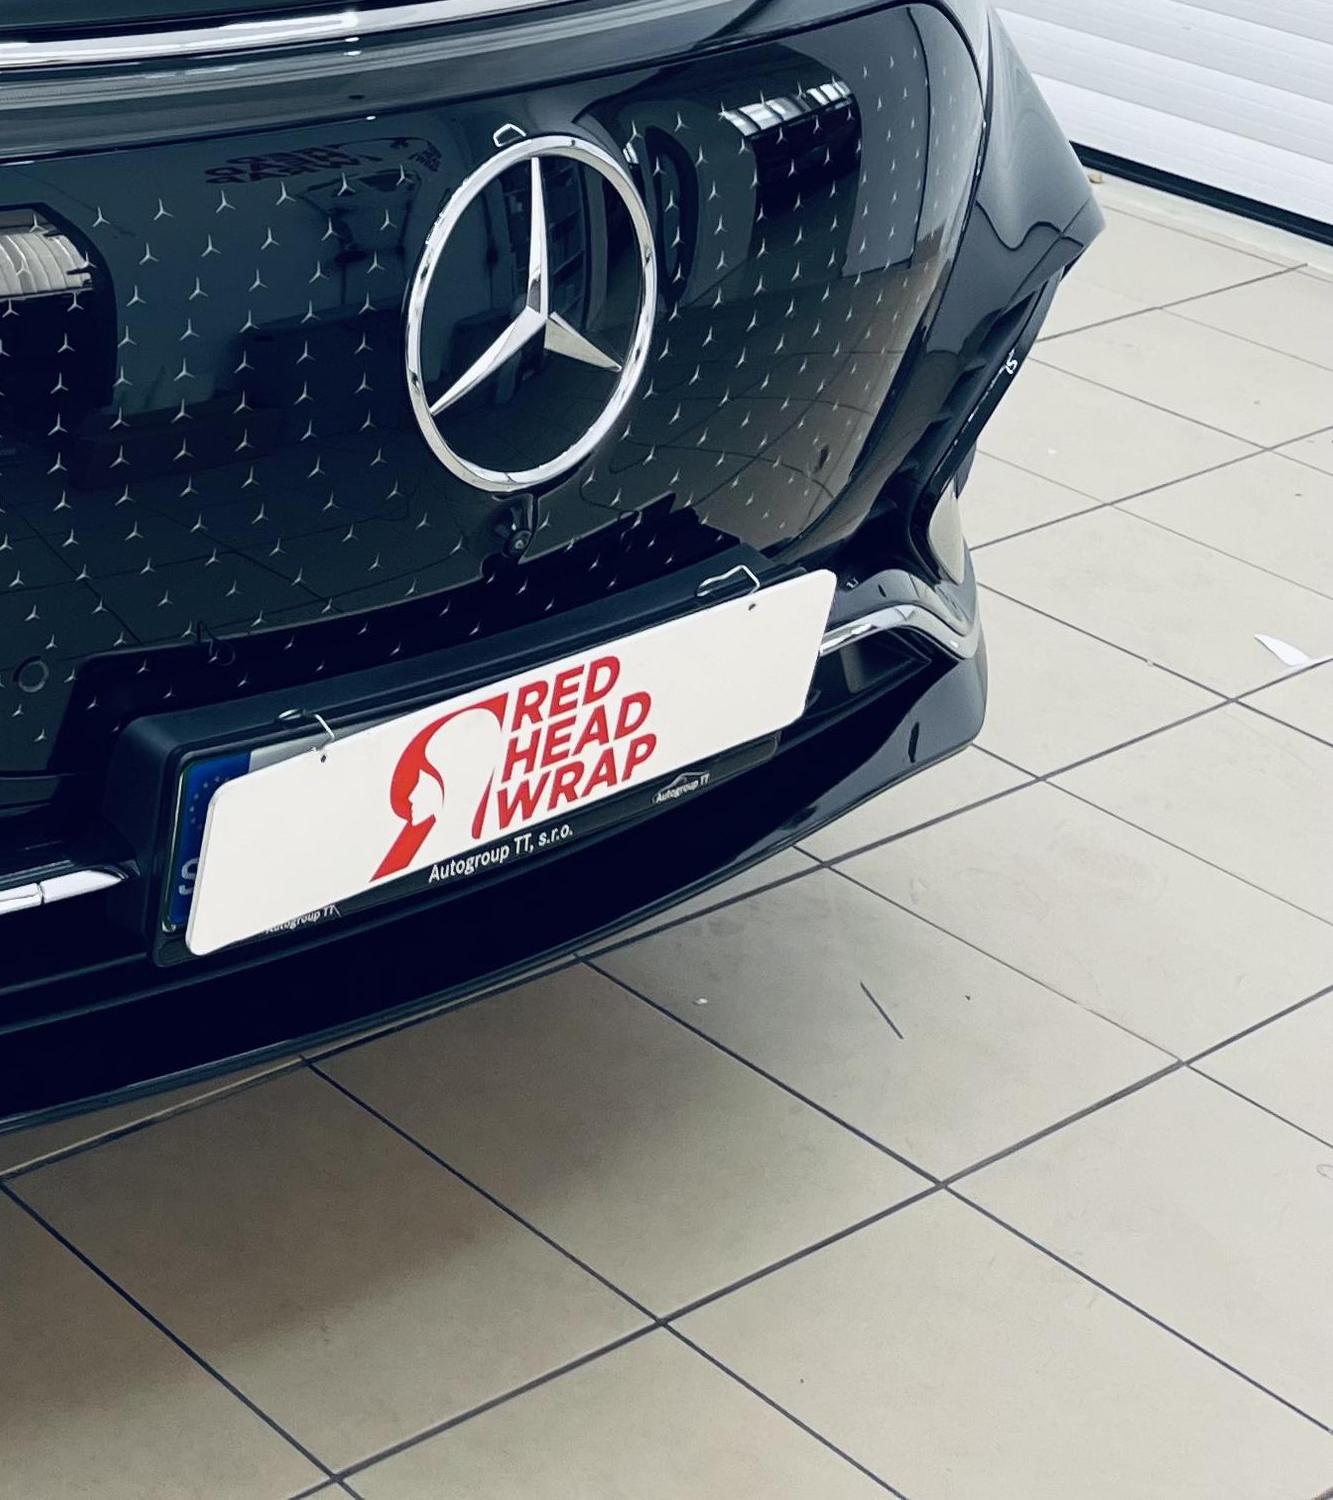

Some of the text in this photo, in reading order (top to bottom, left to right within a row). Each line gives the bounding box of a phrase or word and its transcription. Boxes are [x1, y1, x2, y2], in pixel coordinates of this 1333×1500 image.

[501, 690, 652, 784] HEAD
[511, 655, 621, 733] RED
[497, 732, 657, 831] WRAP
[428, 823, 574, 884] Autogroup TT, s.r.o.
